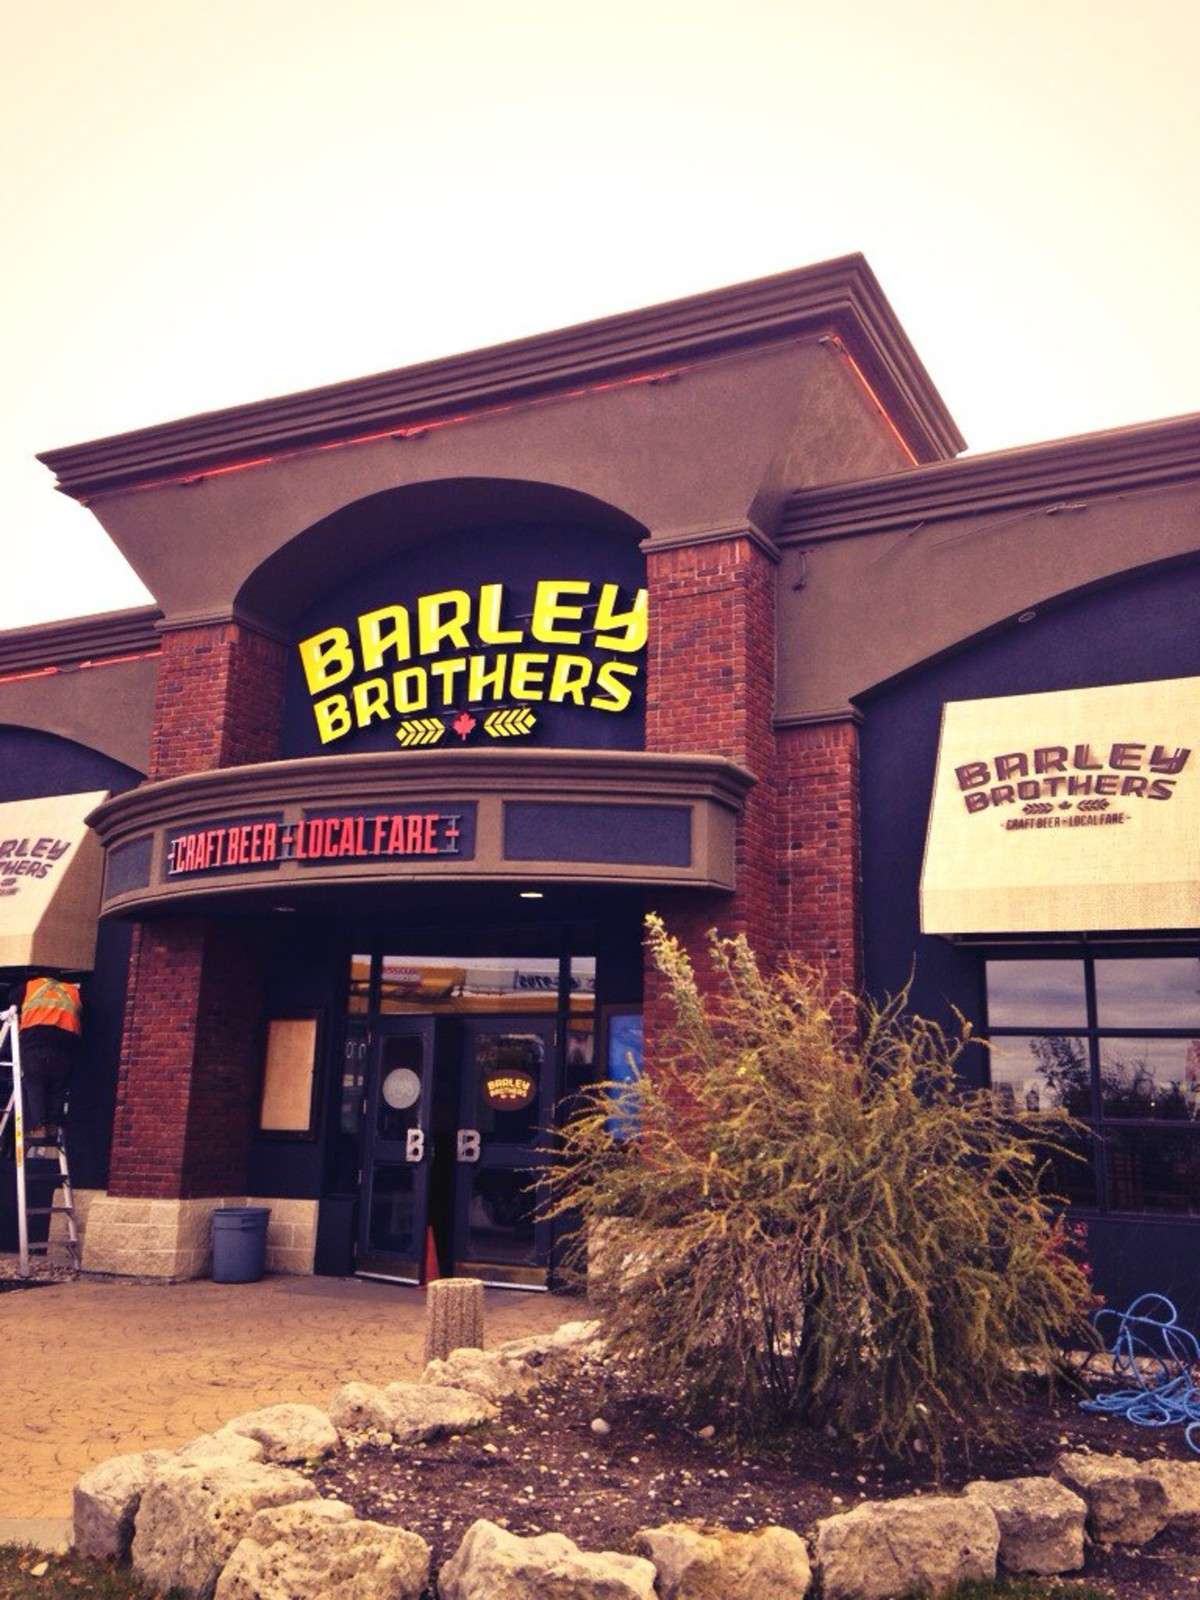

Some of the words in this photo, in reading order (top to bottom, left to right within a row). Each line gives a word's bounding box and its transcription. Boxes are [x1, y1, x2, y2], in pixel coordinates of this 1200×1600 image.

[299, 580, 648, 696] BARLEY
[313, 652, 638, 745] BROTHERS
[954, 743, 1192, 791] BARLEY
[964, 775, 1177, 814] BROTHERS
[1006, 818, 1035, 831] CRAFT
[1068, 814, 1099, 827] LOCAL
[1100, 812, 1125, 825] FARE
[175, 828, 226, 873] CRAFT
[227, 822, 277, 865] BEER
[296, 815, 369, 859] LOCAL
[373, 814, 439, 855] FARE
[488, 1078, 530, 1091] BARLEY
[406, 1128, 424, 1162] B
[457, 1129, 481, 1162] B
